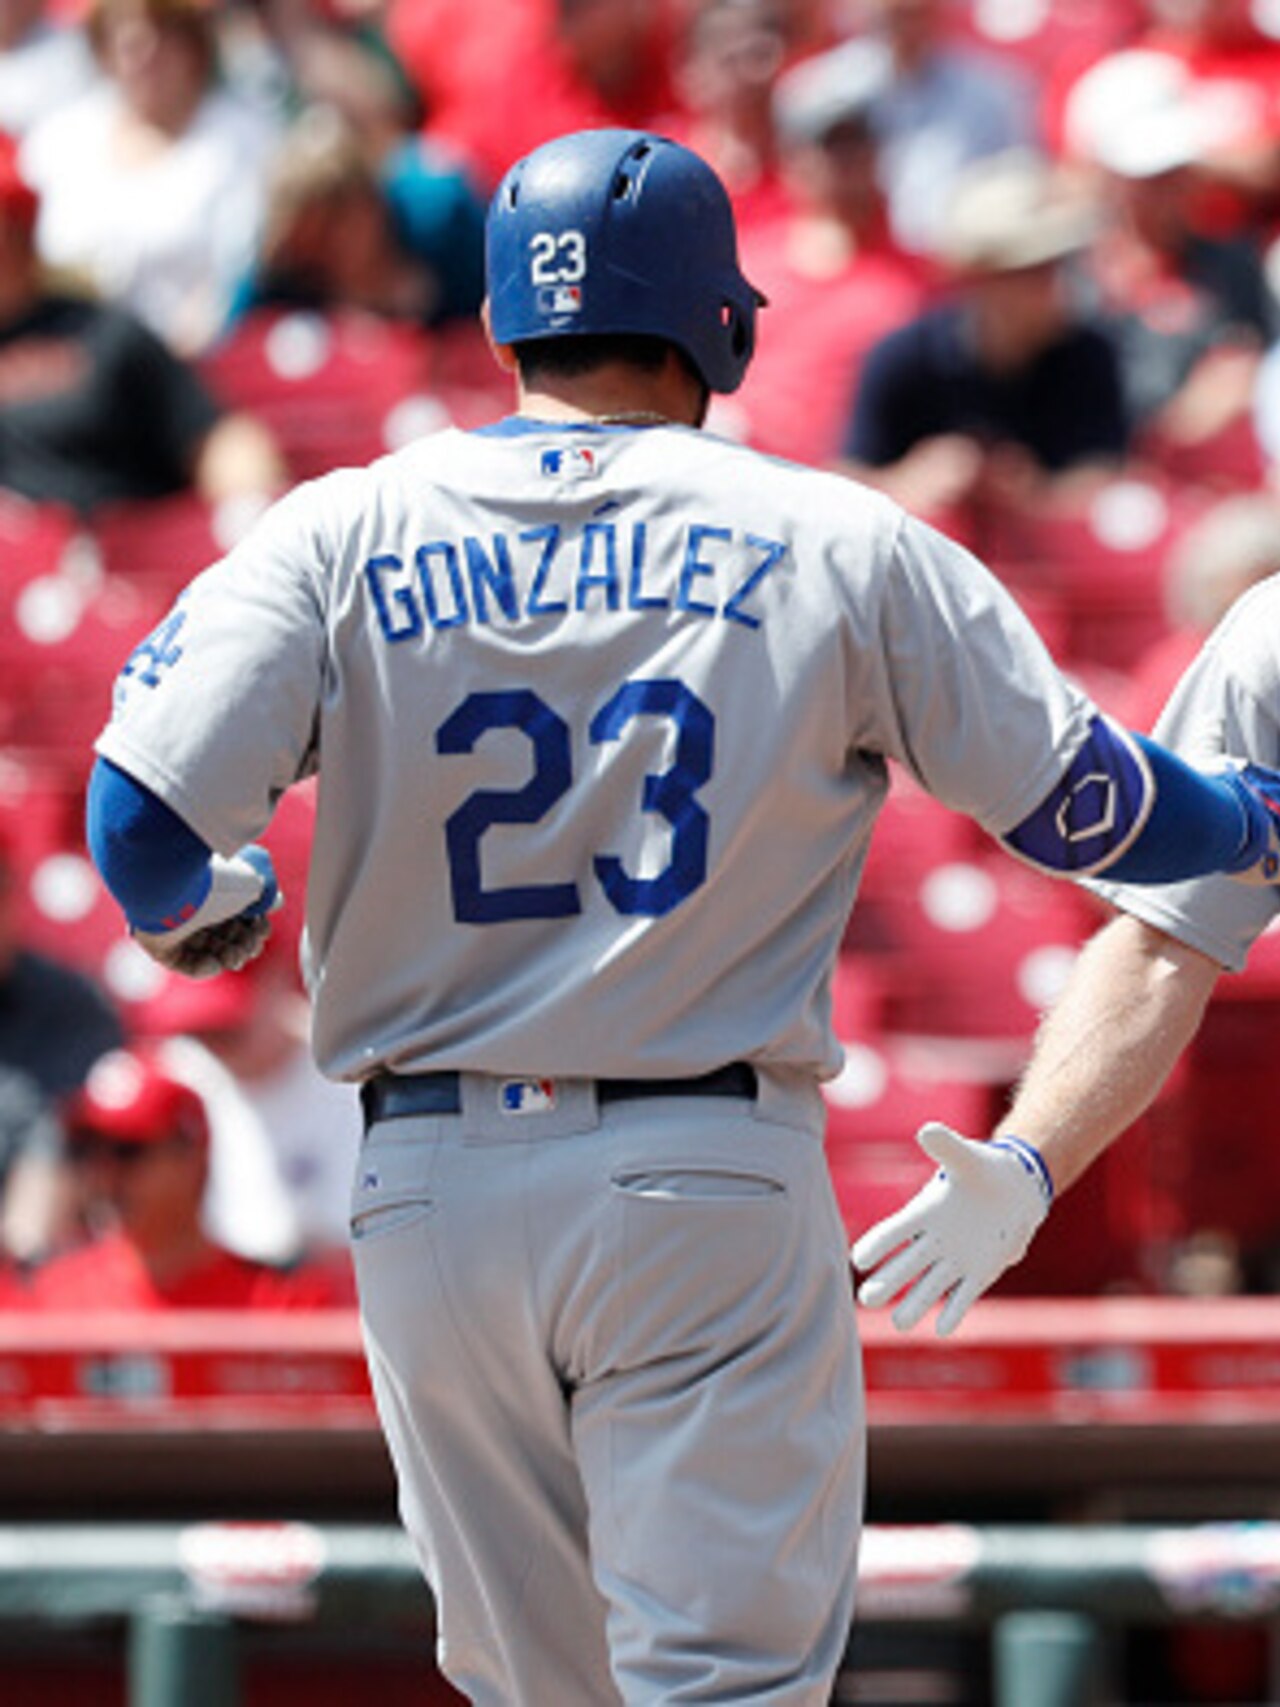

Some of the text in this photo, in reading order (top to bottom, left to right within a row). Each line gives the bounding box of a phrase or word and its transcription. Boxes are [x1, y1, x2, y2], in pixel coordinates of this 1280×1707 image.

[530, 231, 587, 286] 23
[362, 500, 788, 645] GONZÁLEZ
[434, 678, 716, 925] 23
